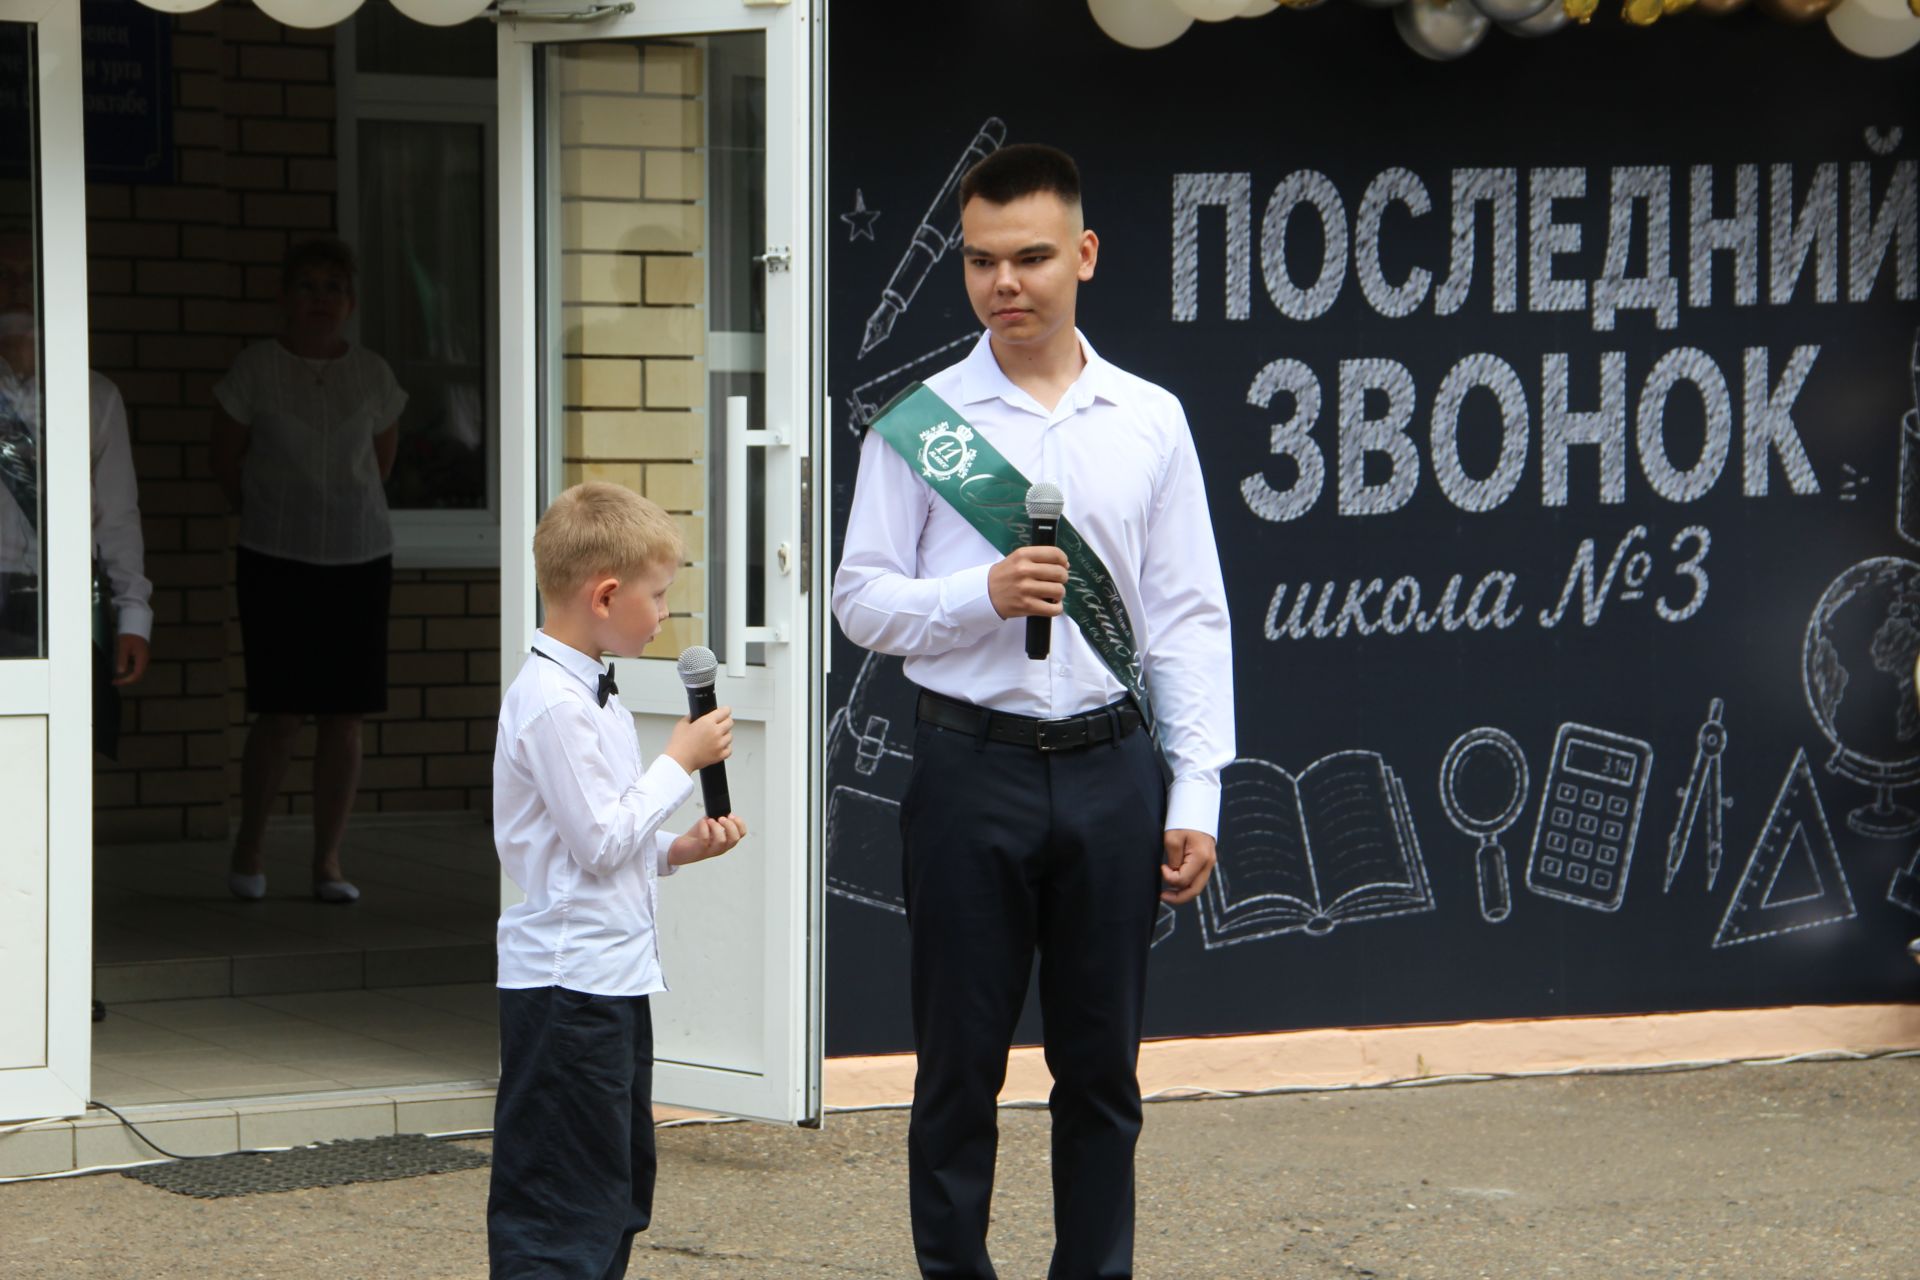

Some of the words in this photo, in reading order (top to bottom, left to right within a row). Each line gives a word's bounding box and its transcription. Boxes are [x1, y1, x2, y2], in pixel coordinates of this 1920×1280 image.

[1171, 126, 1919, 331] ПОСЛЕДНИЙ
[934, 441, 962, 463] 11
[1240, 344, 1821, 522] ЗВОНОК
[1263, 569, 1523, 641] школа
